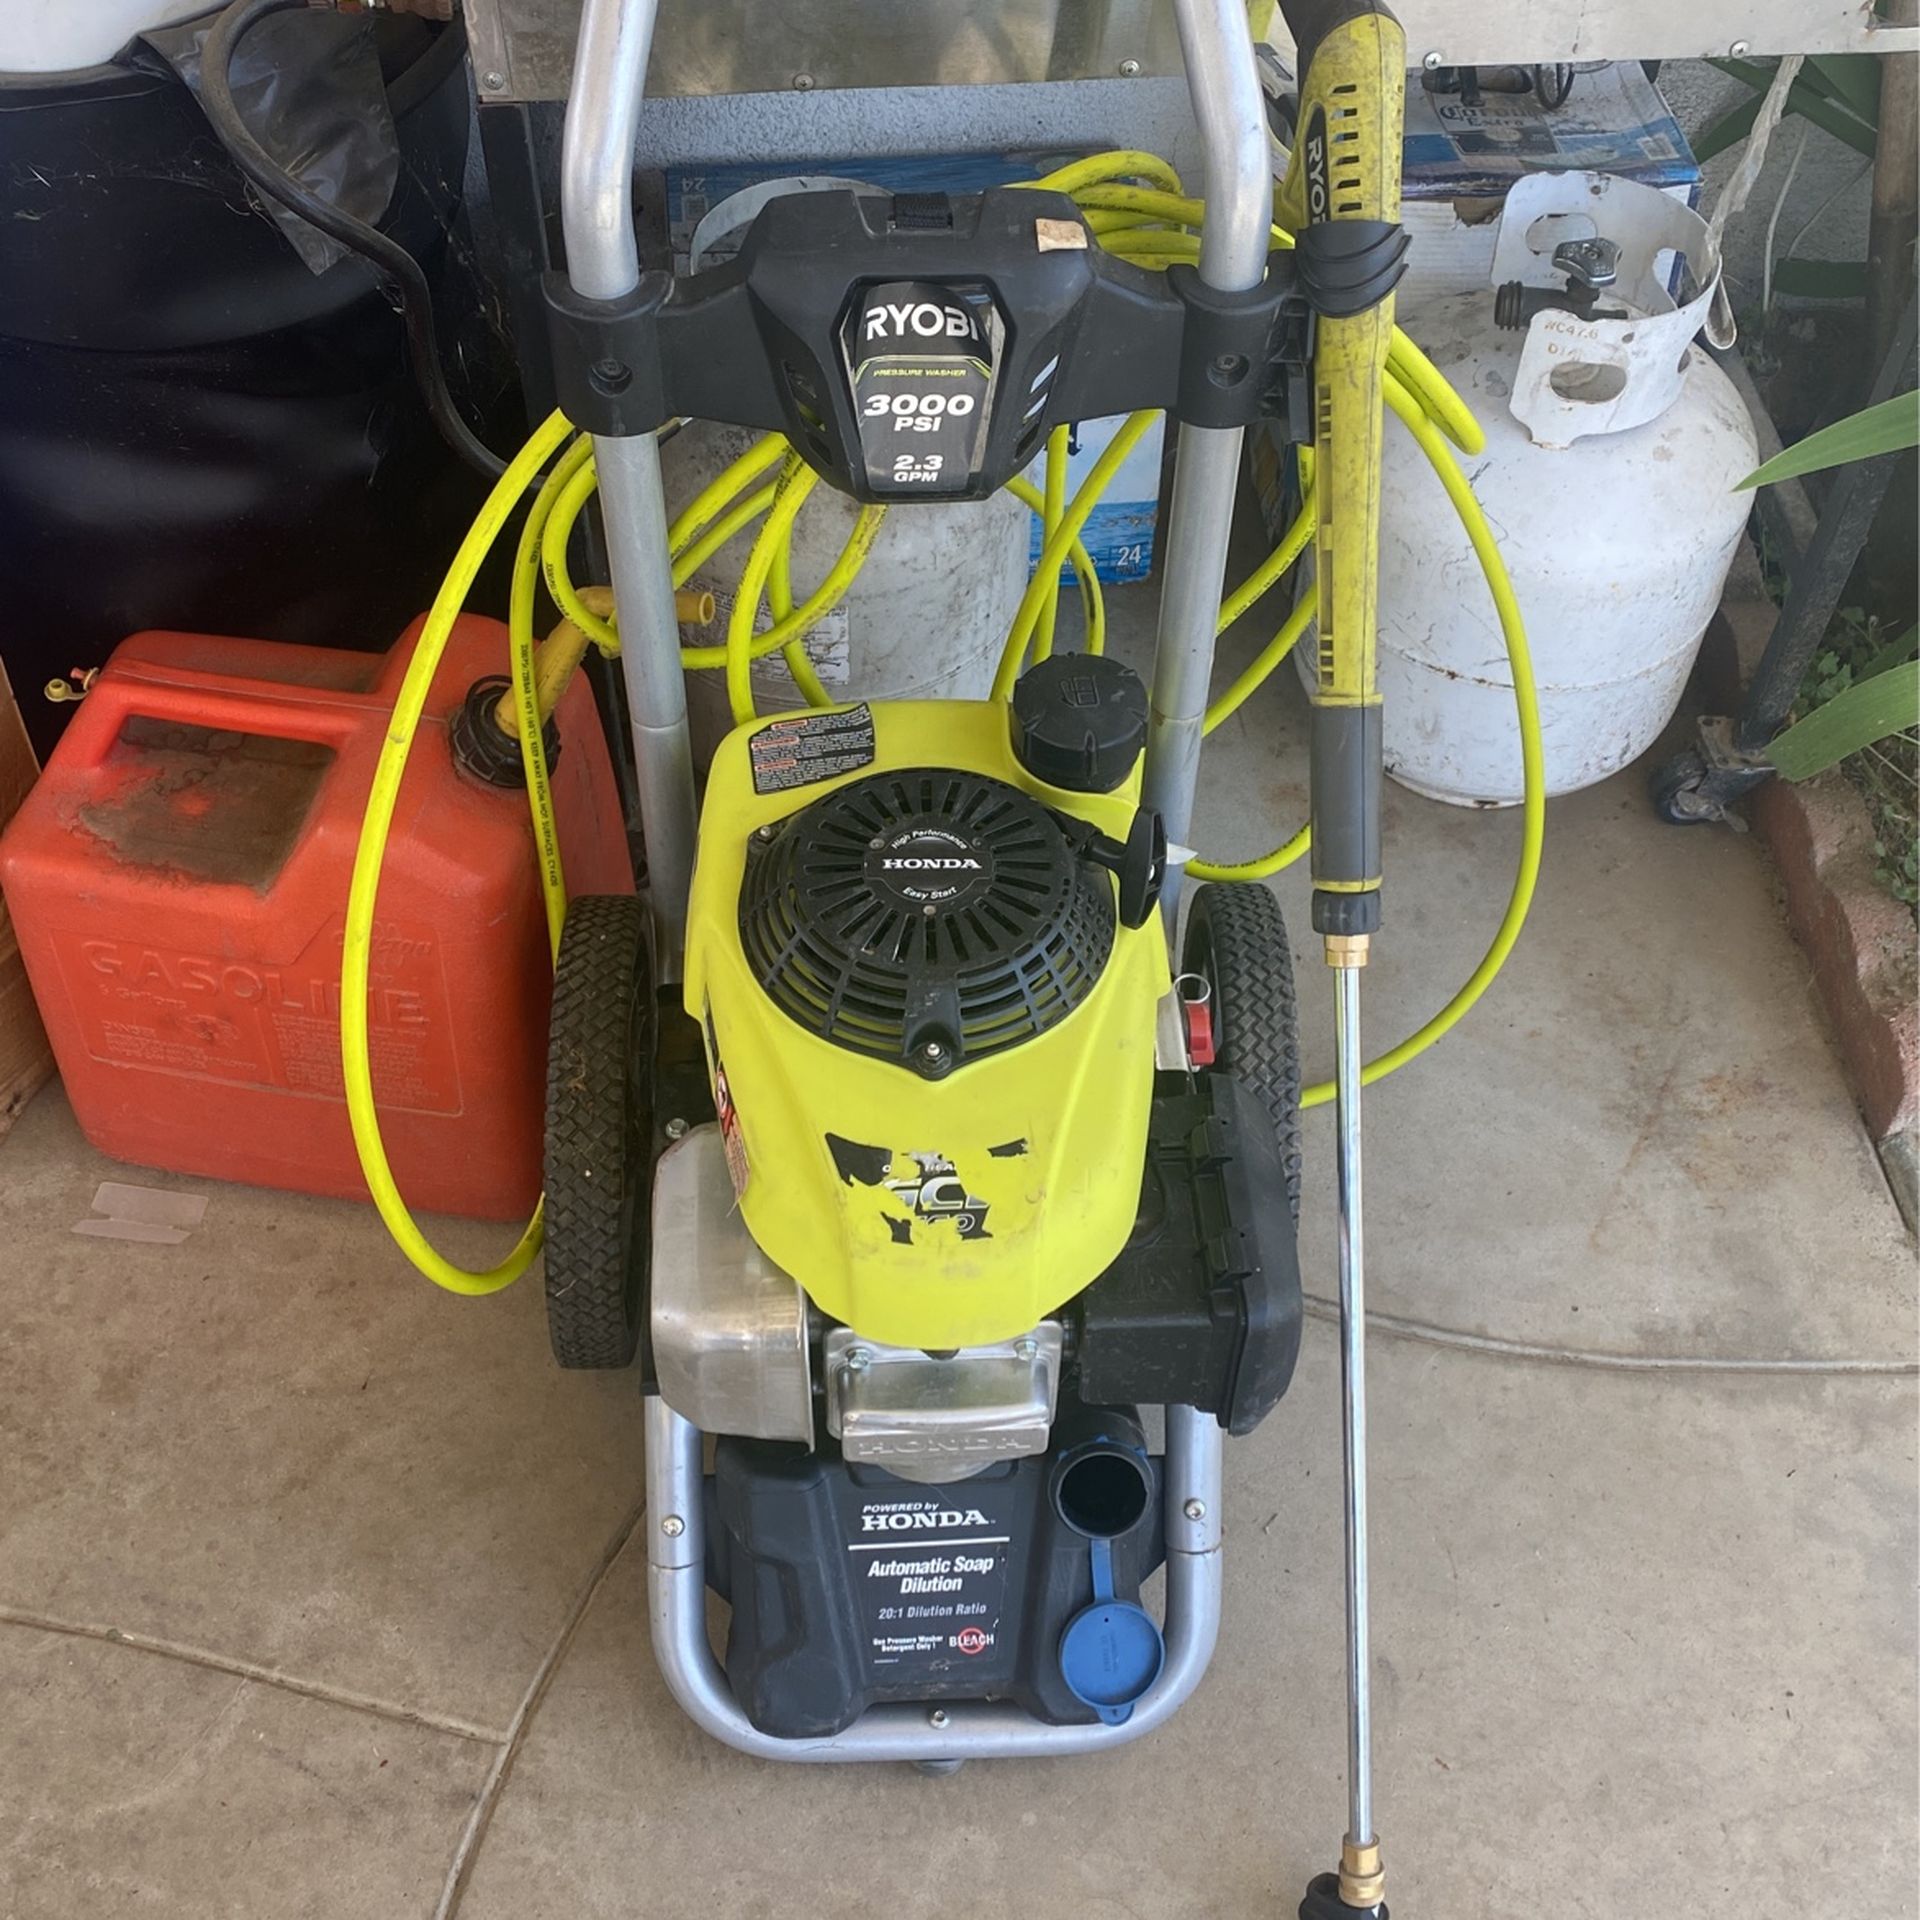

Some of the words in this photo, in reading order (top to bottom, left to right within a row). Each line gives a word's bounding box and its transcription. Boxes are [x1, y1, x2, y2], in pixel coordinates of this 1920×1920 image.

[865, 303, 981, 341] RYOBI
[873, 368, 923, 377] PRESSURE
[925, 368, 968, 377] WASHER
[864, 393, 975, 417] 3000
[894, 416, 942, 432] PSI
[893, 453, 943, 470] 2.3
[893, 471, 938, 482] GPM
[1117, 544, 1142, 566] 24
[891, 834, 911, 850] High
[912, 829, 968, 850] Performance
[882, 858, 983, 869] HONDA
[902, 886, 929, 900] Easy
[930, 886, 957, 900] Start
[859, 1437, 1032, 1456] HONDA
[863, 1503, 923, 1513] POWERED
[924, 1502, 939, 1512] by
[862, 1509, 989, 1531] HONDA
[868, 1558, 950, 1577] Automatic
[953, 1556, 994, 1575] Soap
[900, 1577, 963, 1594] Dilution
[878, 1607, 903, 1620] 20:1
[907, 1604, 953, 1618] Dilution
[956, 1603, 987, 1616] Ratio
[949, 1633, 994, 1648] BLEACH
